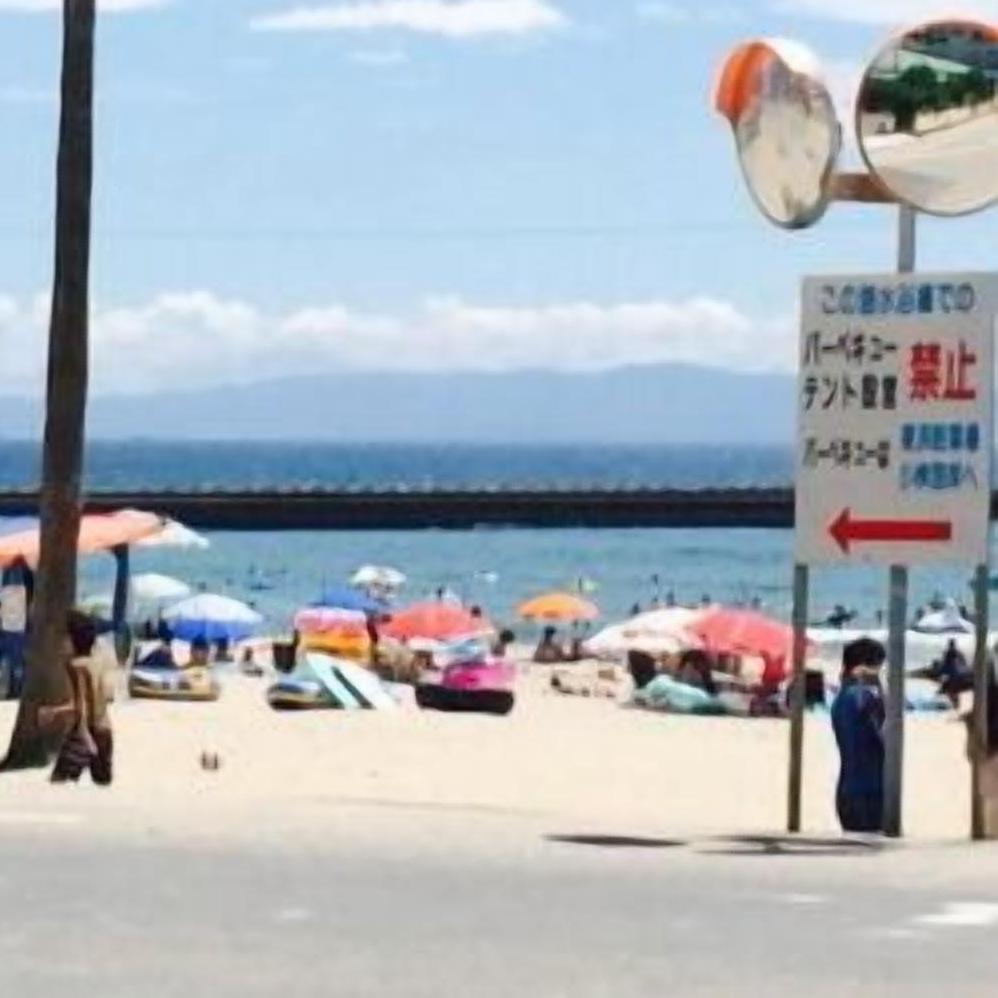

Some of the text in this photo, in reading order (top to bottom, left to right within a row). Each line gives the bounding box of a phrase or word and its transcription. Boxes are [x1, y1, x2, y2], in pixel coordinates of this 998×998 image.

[822, 283, 976, 314] この水での
[910, 339, 978, 401] 禁止
[803, 374, 898, 410] テント
